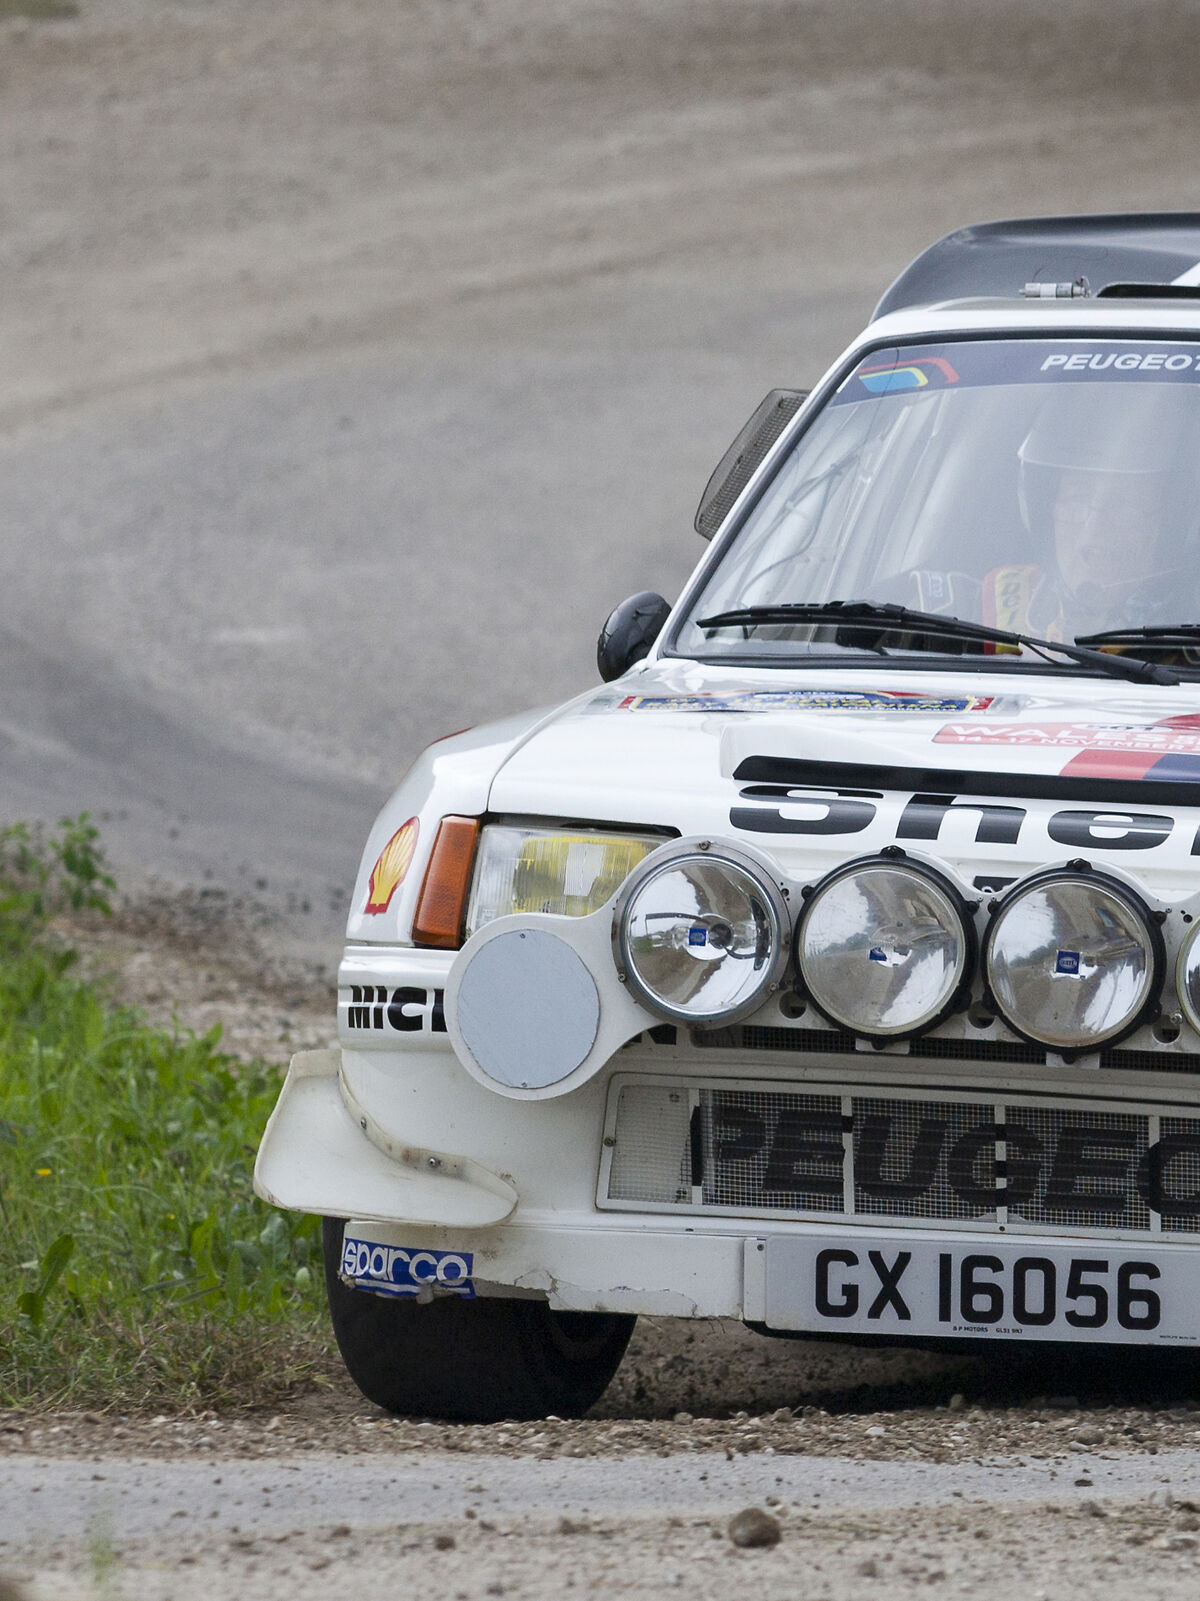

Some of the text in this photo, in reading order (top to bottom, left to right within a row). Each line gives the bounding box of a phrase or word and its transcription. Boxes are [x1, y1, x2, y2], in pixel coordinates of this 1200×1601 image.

[950, 725, 1167, 742] WALES
[1039, 739, 1182, 751] NOVEMBER
[344, 1241, 468, 1286] sparco
[815, 1248, 1163, 1331] GX 16056
